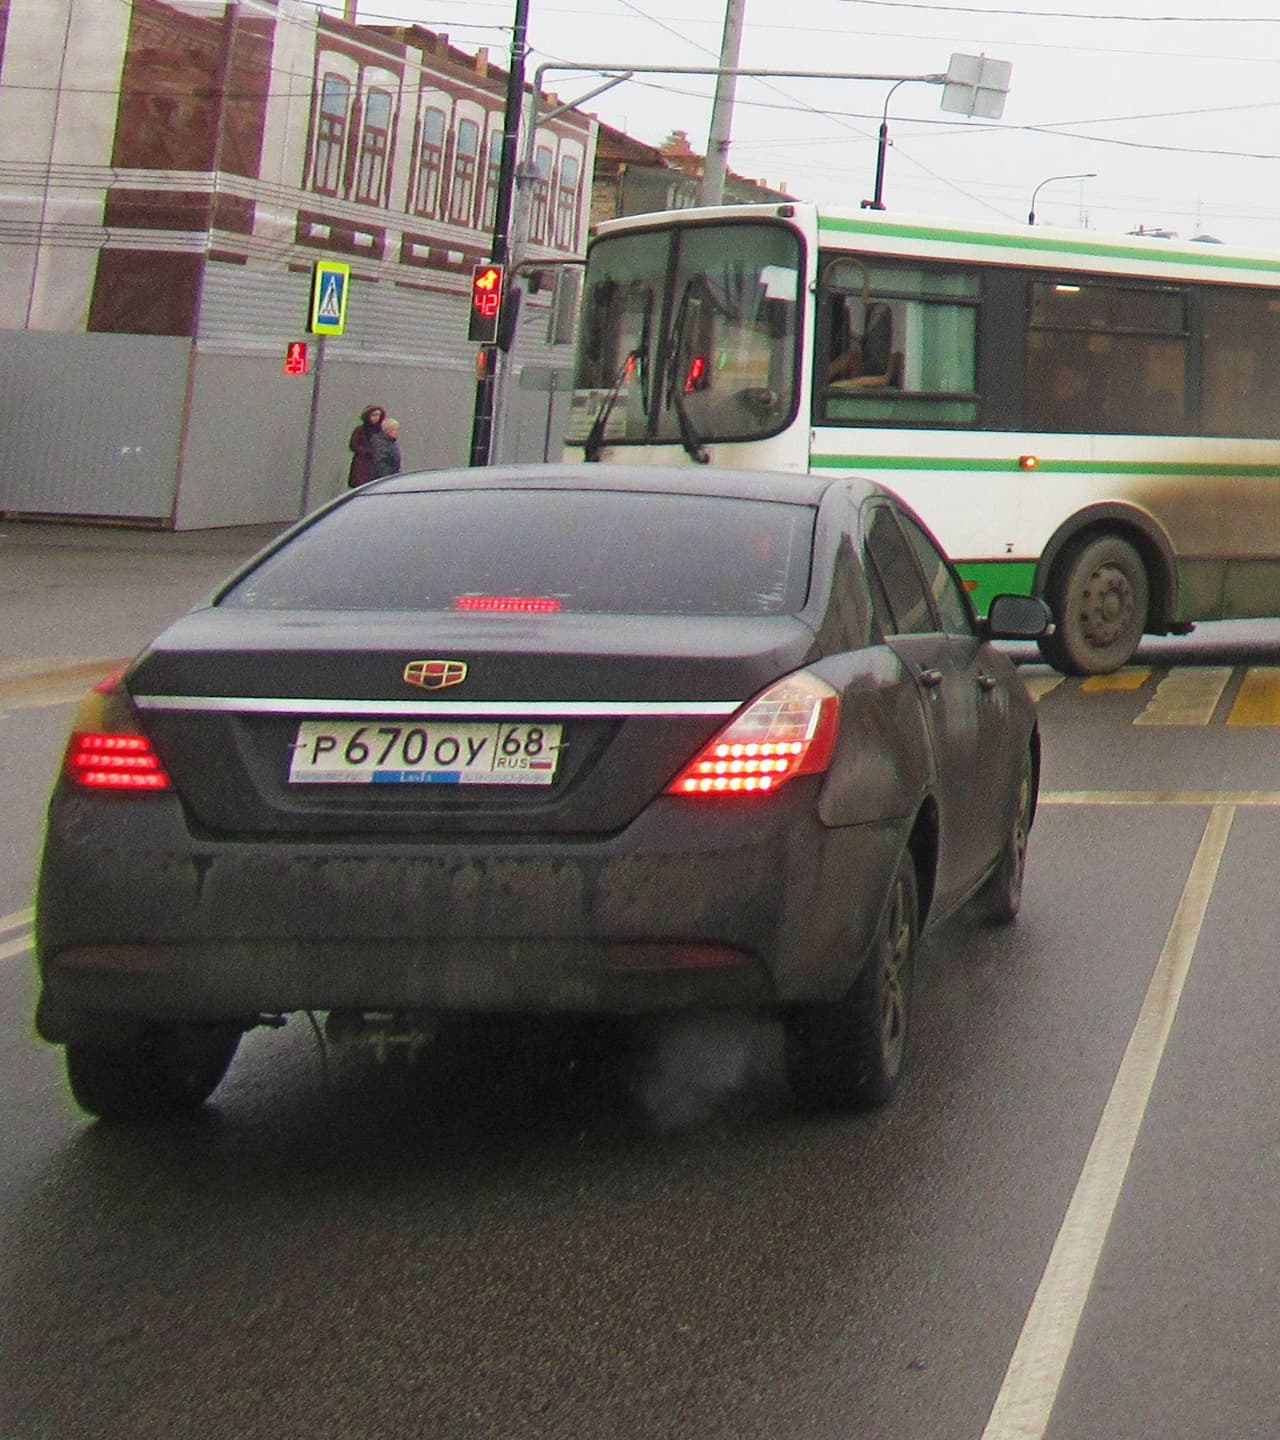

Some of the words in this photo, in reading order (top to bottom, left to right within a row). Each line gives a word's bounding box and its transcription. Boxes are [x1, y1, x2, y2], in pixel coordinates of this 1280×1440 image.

[474, 294, 498, 316] 42
[501, 726, 545, 757] 68
[497, 758, 529, 770] RUS
